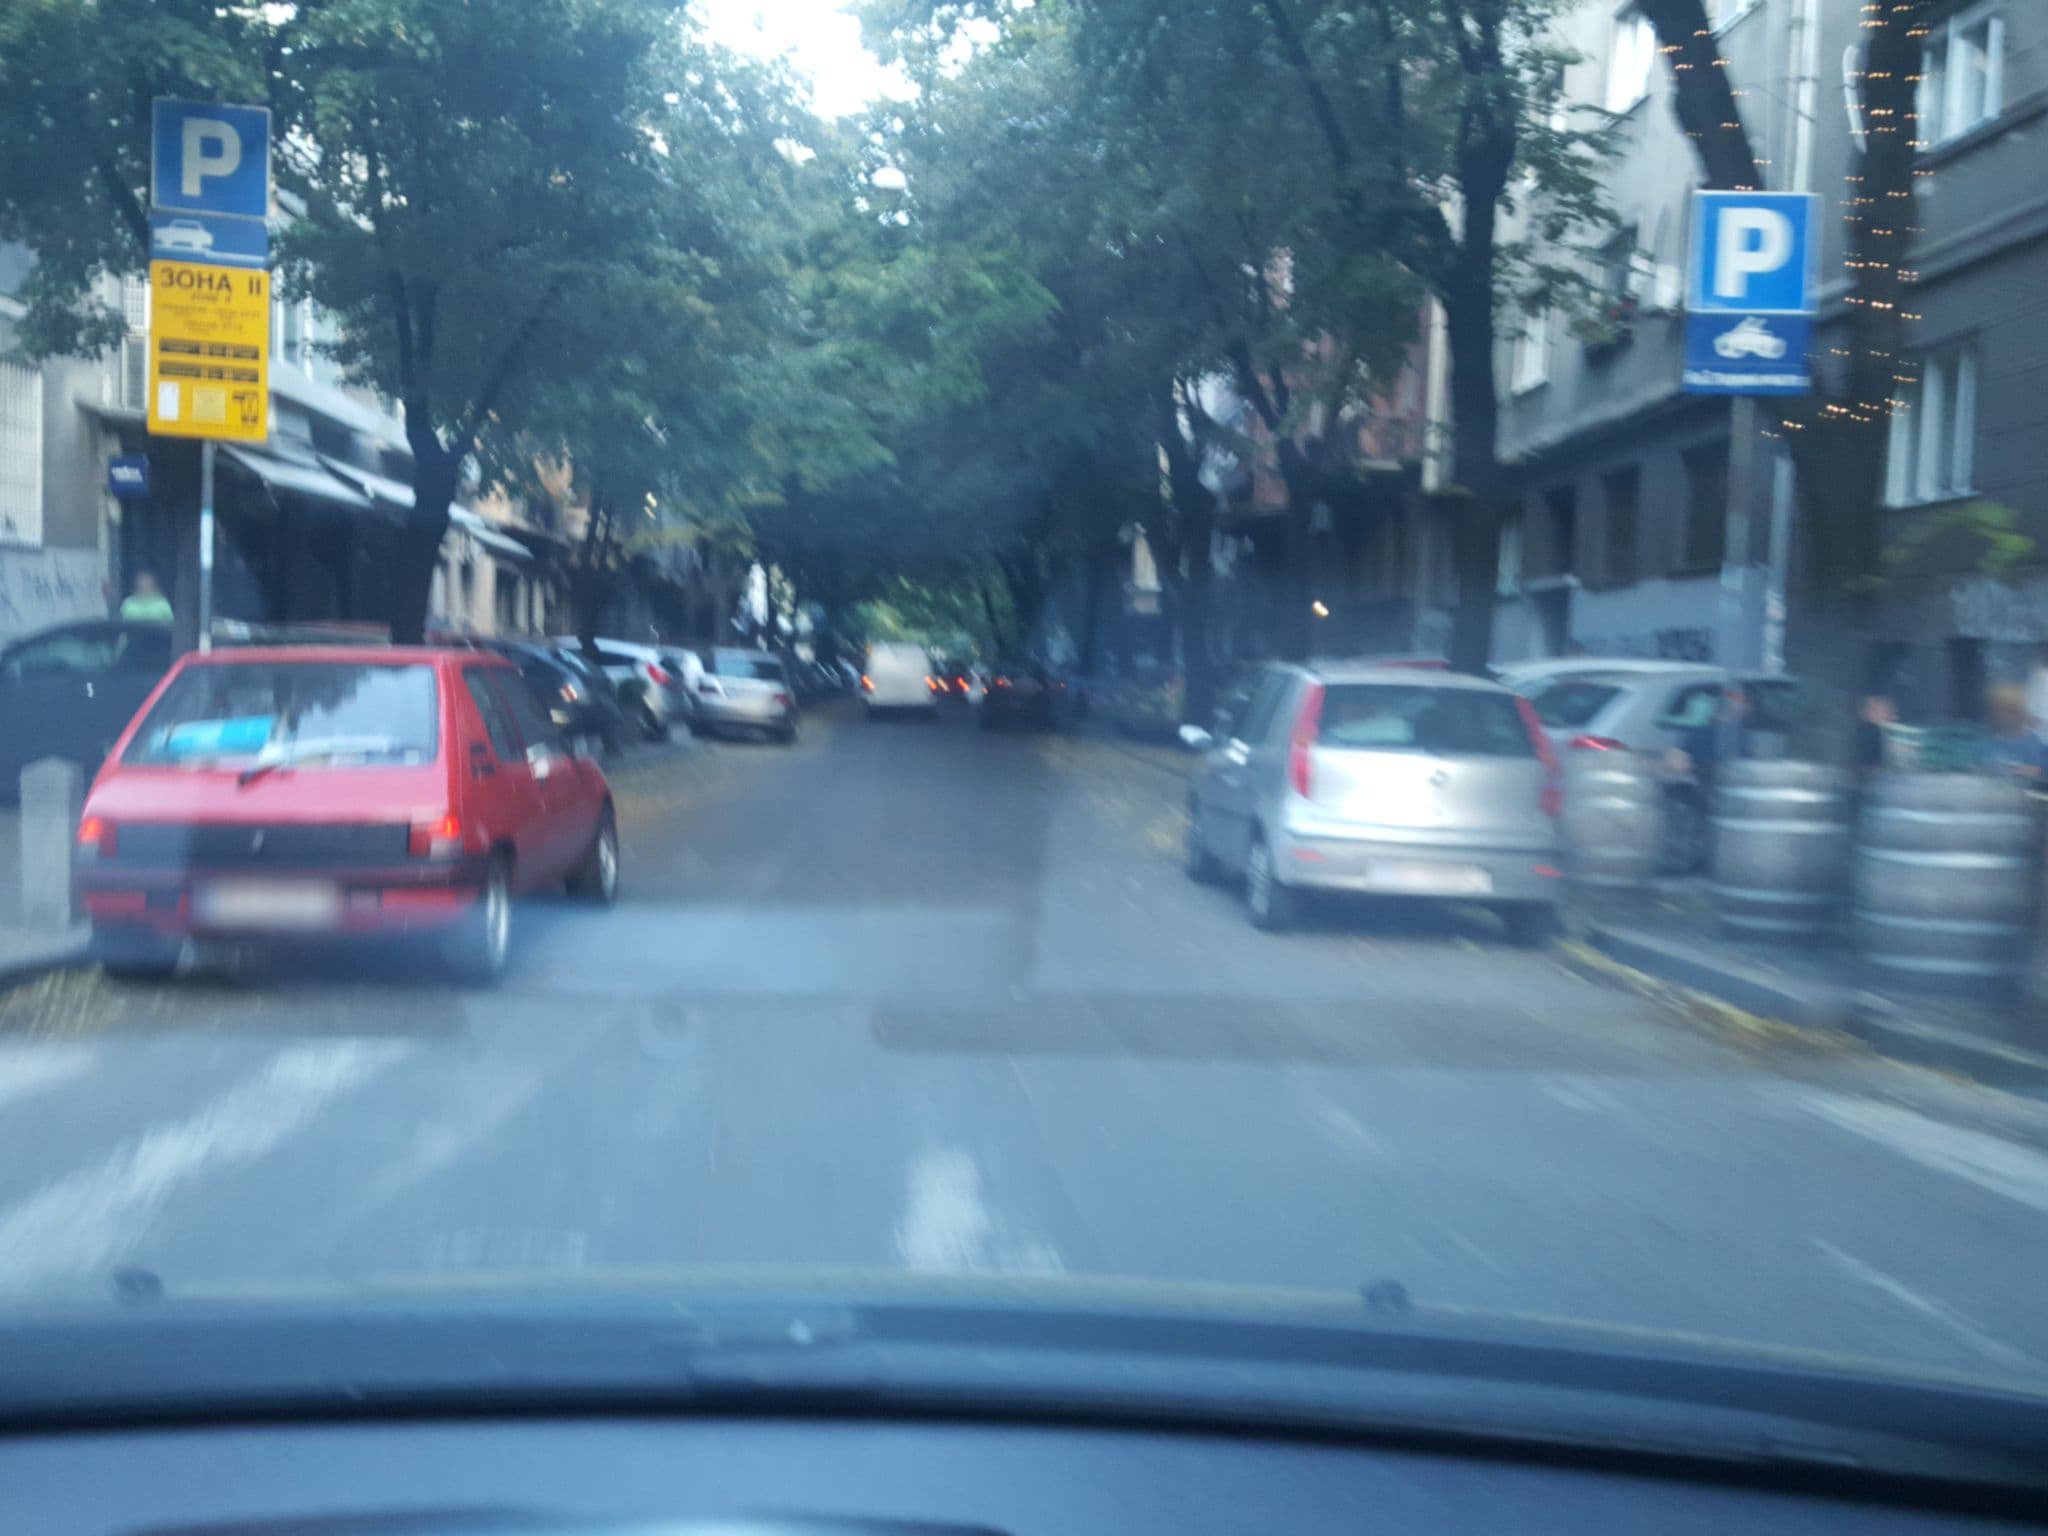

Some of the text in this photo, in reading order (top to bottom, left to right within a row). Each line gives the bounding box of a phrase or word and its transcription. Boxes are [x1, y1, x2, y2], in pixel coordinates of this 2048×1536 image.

[182, 118, 241, 196] P
[161, 267, 231, 292] ЗОНА
[1713, 207, 1794, 298] P
